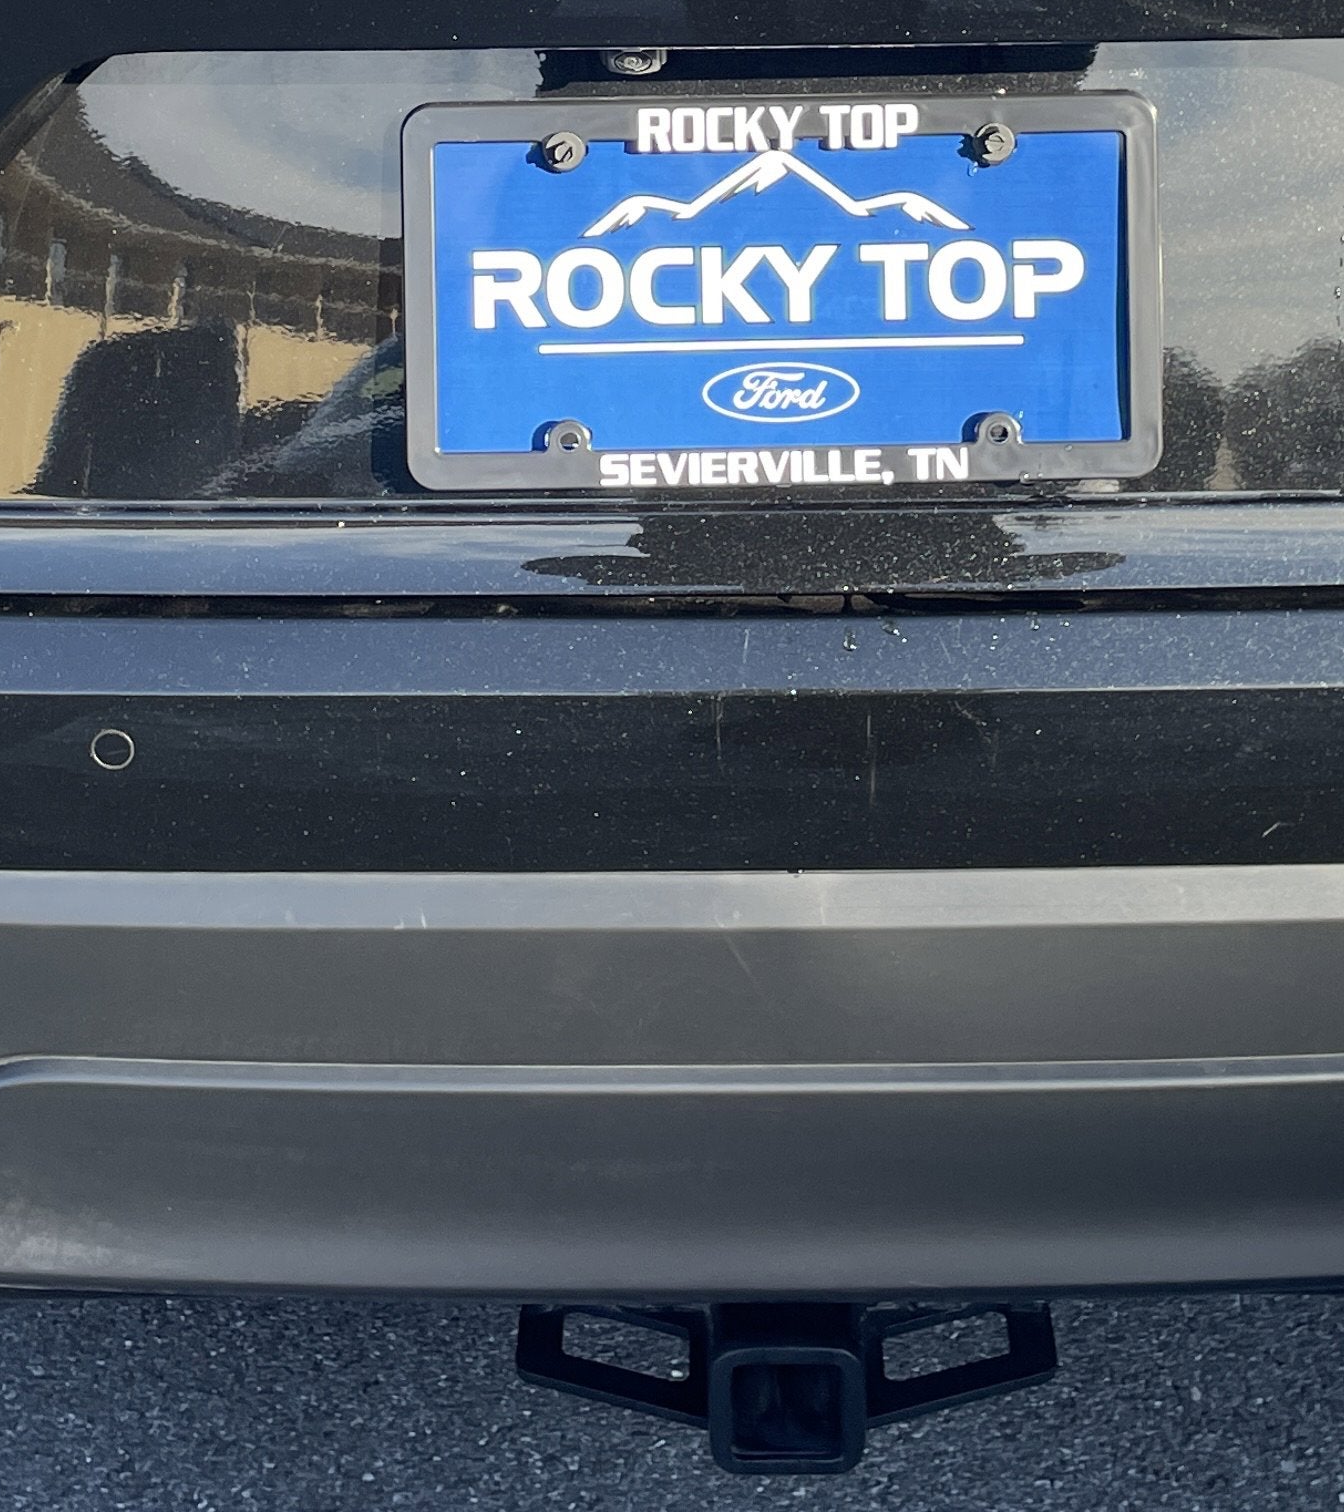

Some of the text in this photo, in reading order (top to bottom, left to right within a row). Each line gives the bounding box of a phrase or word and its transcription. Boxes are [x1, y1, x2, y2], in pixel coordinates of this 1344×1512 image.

[636, 102, 920, 153] ROCKY TOP
[471, 240, 1087, 330] ROCKY TOP
[731, 369, 827, 412] Ford
[598, 446, 970, 487] SEVIERVILLE, TN
